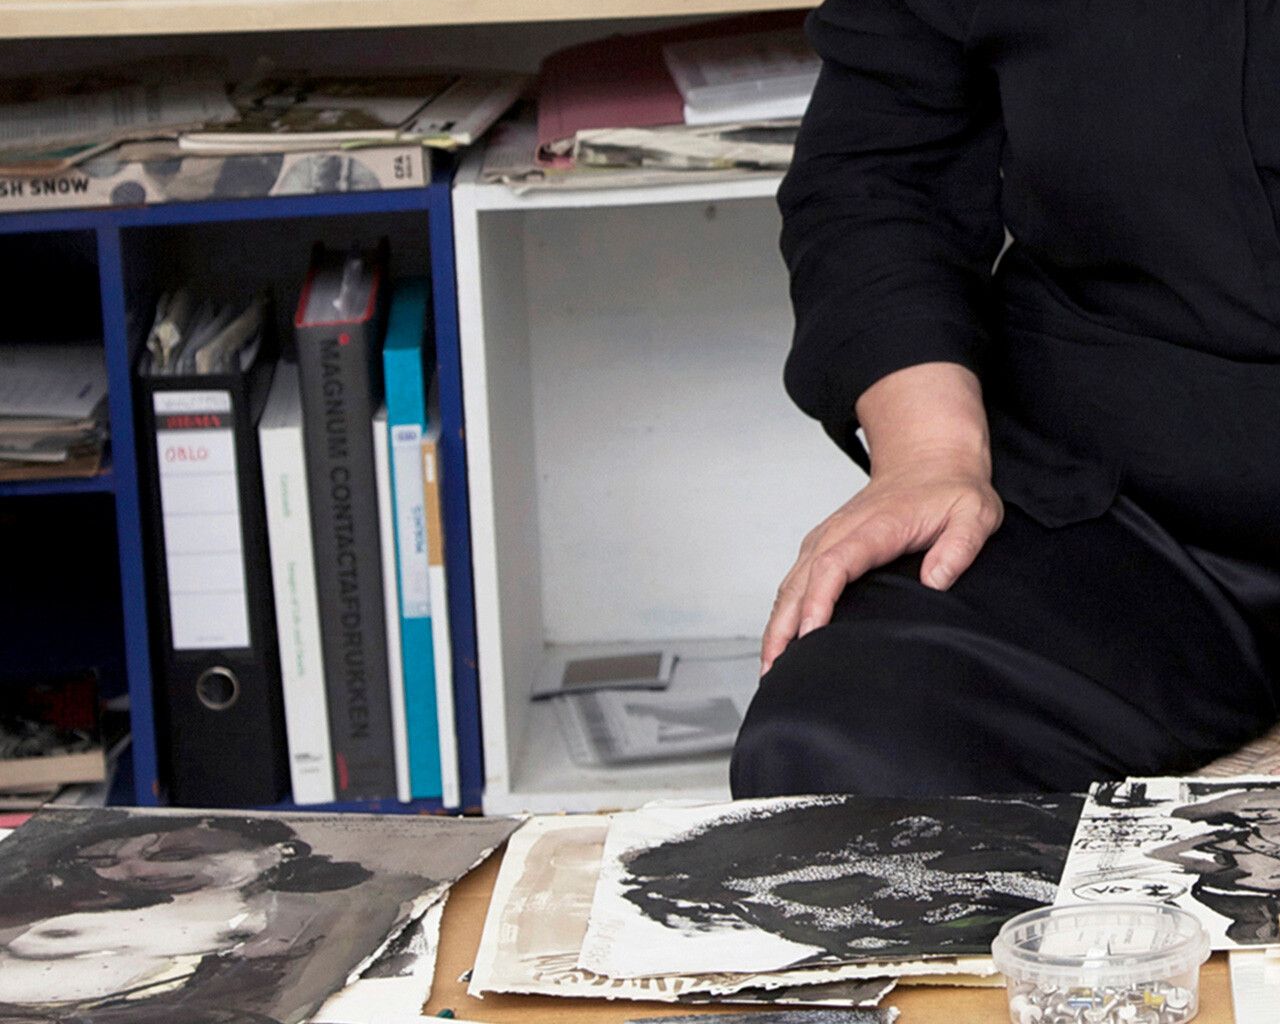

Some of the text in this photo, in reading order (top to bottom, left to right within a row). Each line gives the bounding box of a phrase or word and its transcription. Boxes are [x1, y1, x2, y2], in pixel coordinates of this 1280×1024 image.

[30, 178, 89, 195] SNOW
[319, 339, 373, 740] MAGNUM CONTACTAFDRUKKEN
